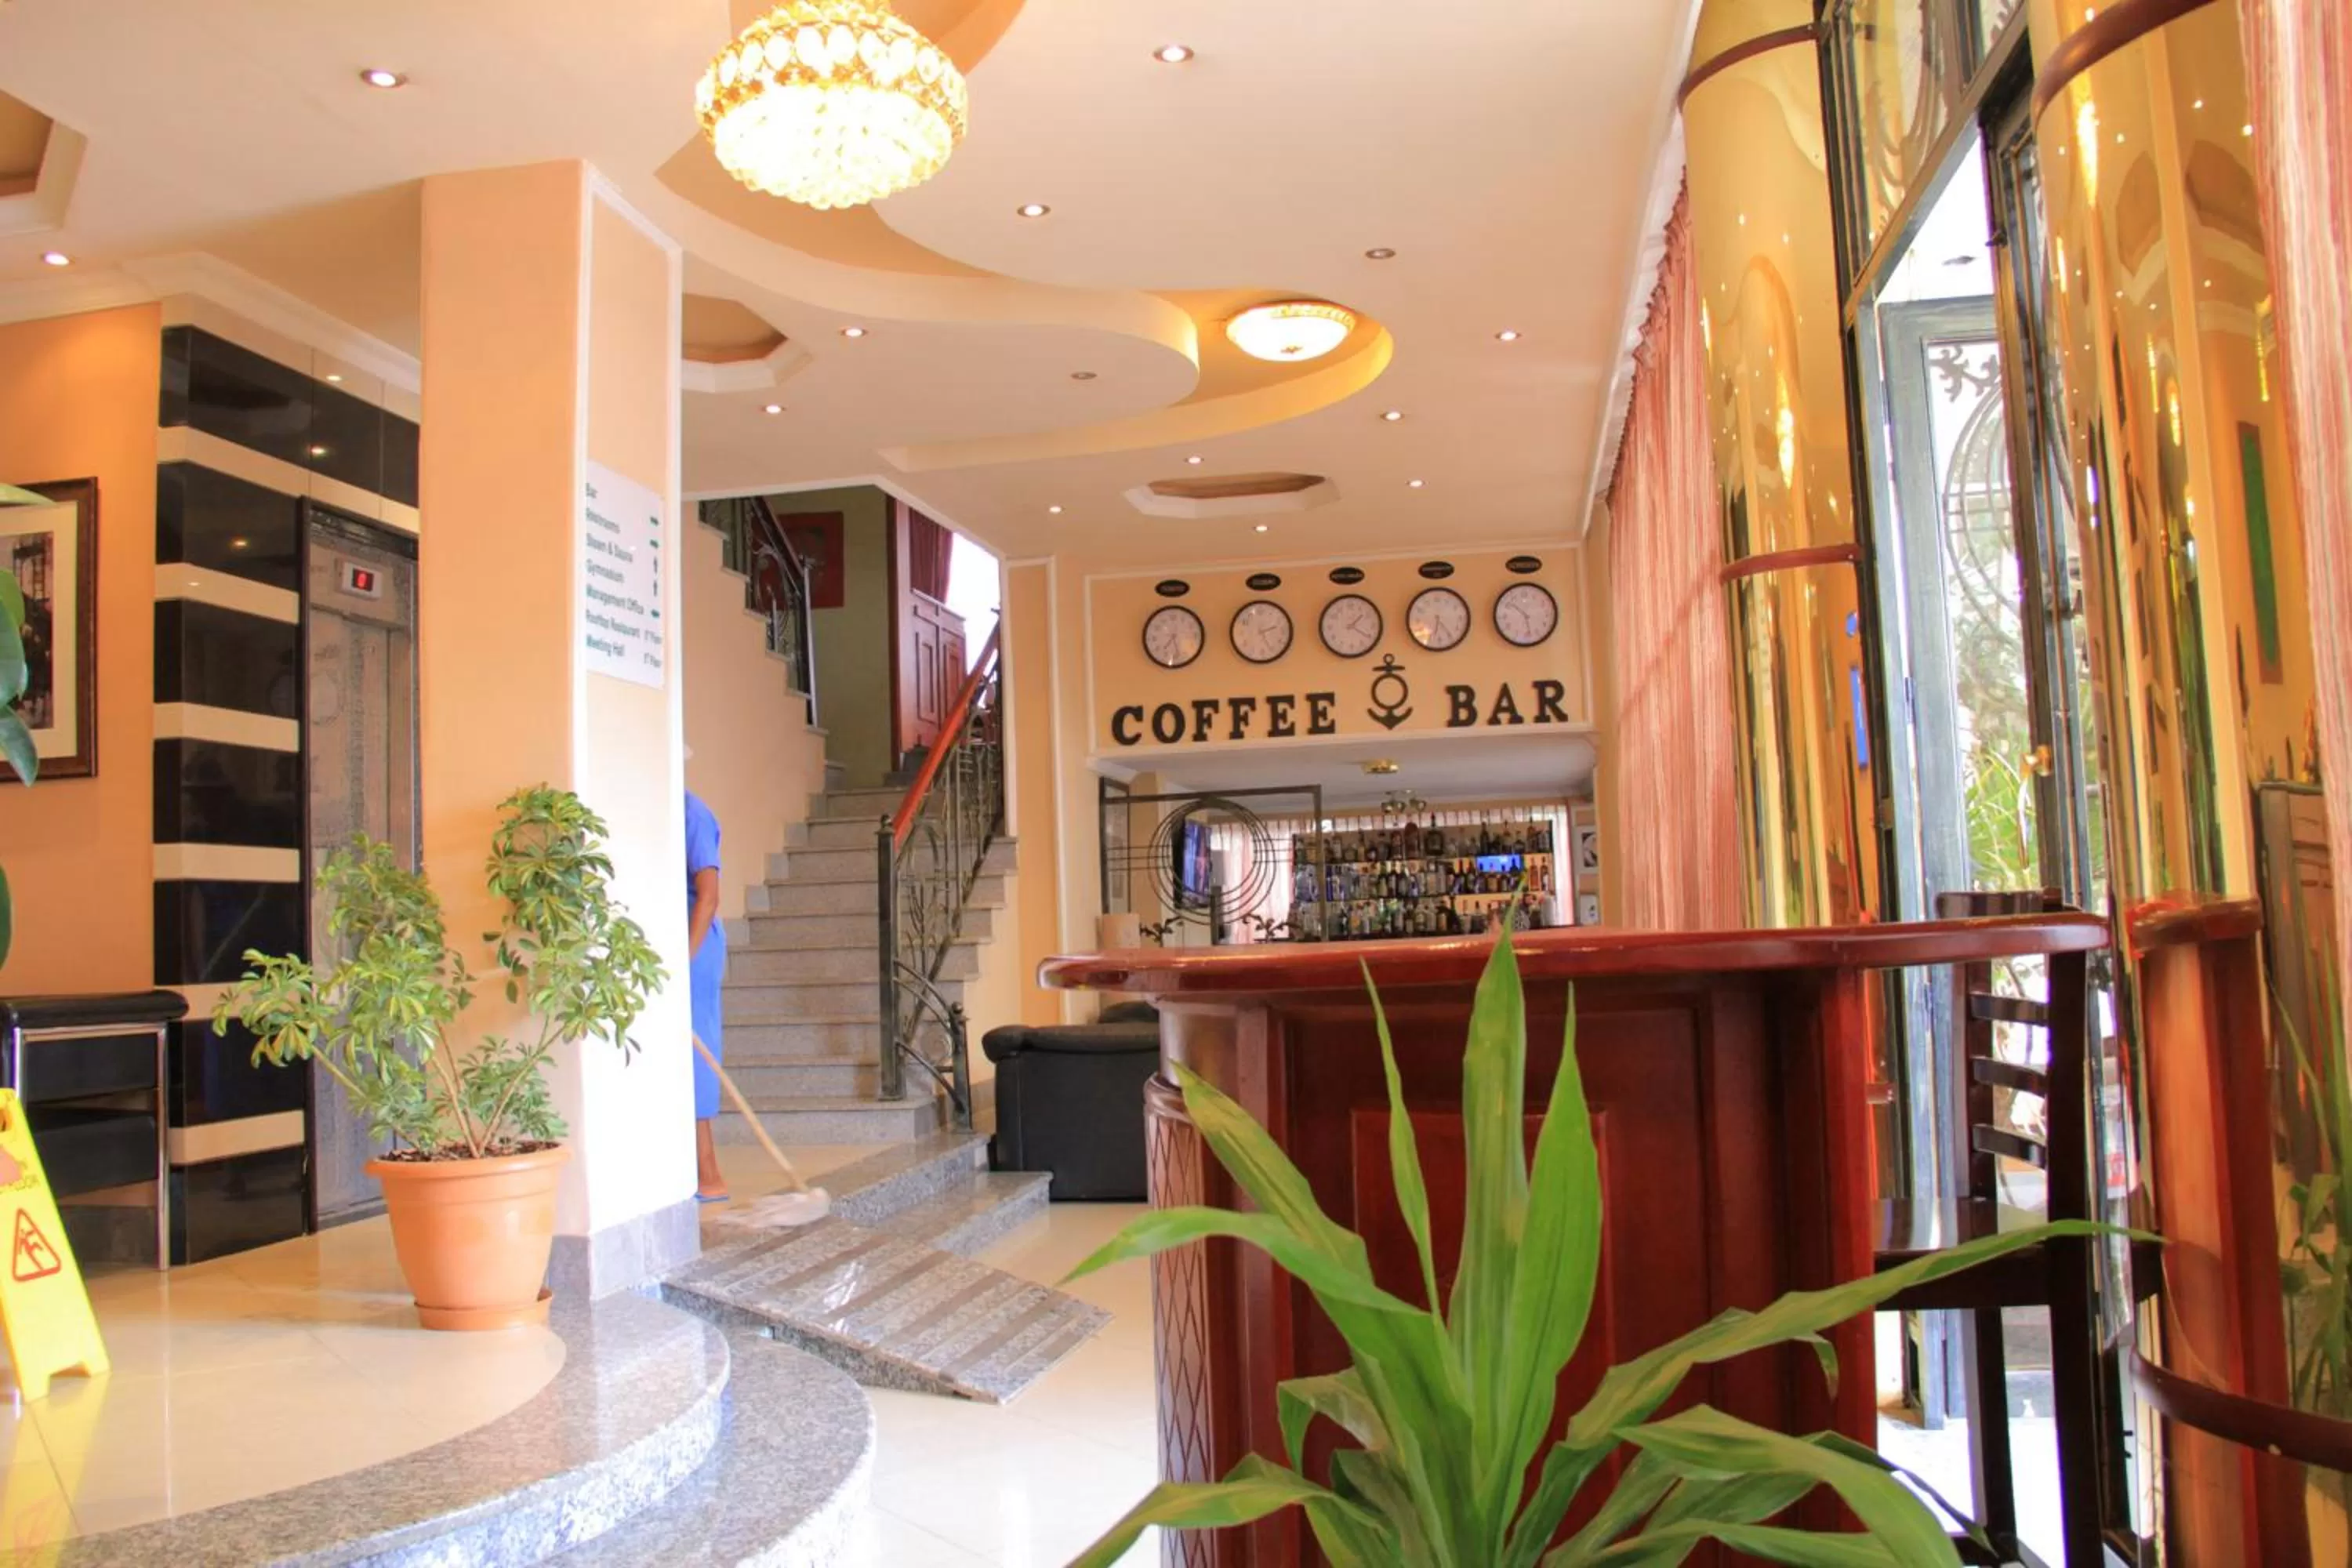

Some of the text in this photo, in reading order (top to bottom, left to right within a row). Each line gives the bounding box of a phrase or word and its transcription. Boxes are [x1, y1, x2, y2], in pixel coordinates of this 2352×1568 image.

[586, 584, 626, 609] Management
[1111, 680, 1569, 746] COFFEE BAR
